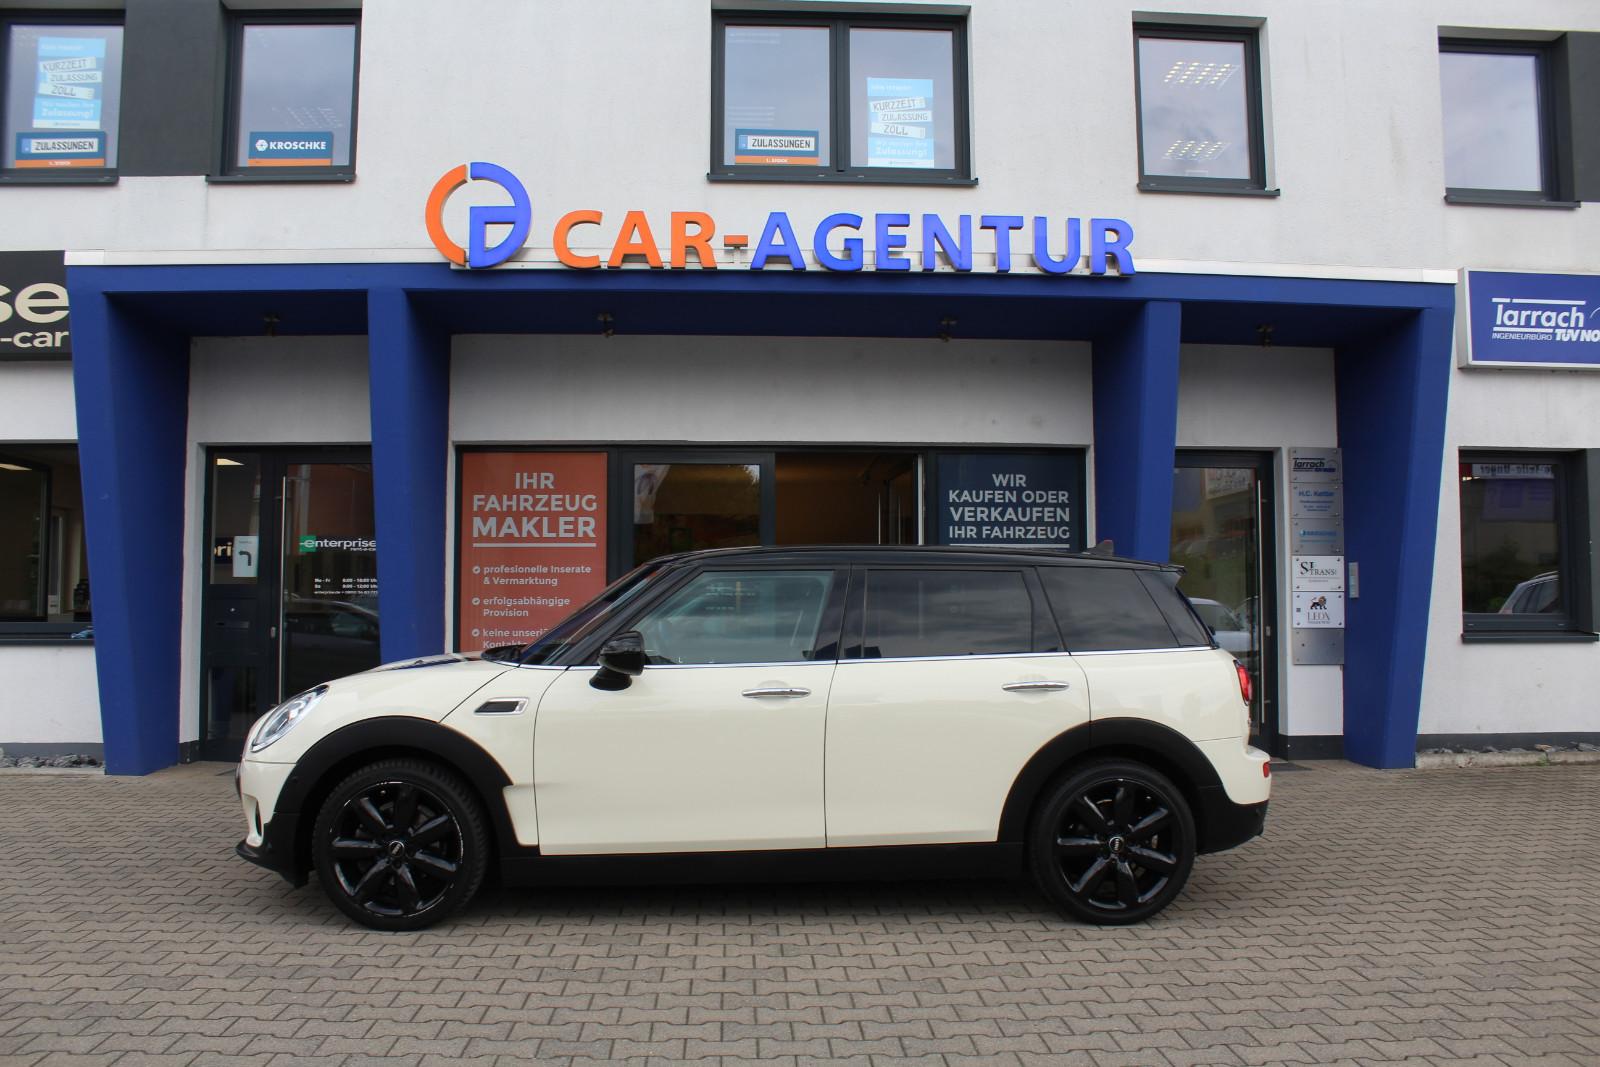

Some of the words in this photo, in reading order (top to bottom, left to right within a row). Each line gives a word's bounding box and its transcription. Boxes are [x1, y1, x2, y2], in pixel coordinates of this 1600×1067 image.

[51, 84, 76, 96] ZOLL
[884, 124, 908, 136] ZOLL
[35, 141, 95, 151] ZULASSUNGEN
[269, 141, 327, 150] KROSCHKE
[751, 138, 811, 149] ZULASSUNGEN
[552, 209, 1136, 276] CAR-AGENTUR
[1492, 297, 1585, 327] Tarrach
[515, 472, 555, 489] IHR
[992, 473, 1027, 487] WIR
[472, 494, 597, 511] FAHRZEUG
[949, 490, 1017, 503] KAUFEN
[1022, 490, 1069, 503] ODER
[950, 506, 1070, 522] VERKAUFEN
[472, 516, 596, 538] MAKLER
[949, 526, 977, 538] IHR
[982, 526, 1070, 539] FAHRZEUG
[300, 538, 376, 550] enterprise
[483, 565, 548, 575] profesionelle
[551, 565, 592, 573] Inserate
[483, 577, 490, 585] &
[492, 577, 558, 586] Vermarktung
[483, 596, 570, 607] erfolgsabhängige
[483, 608, 529, 617] Provision
[483, 628, 510, 637] keine
[512, 628, 549, 637] unseri
